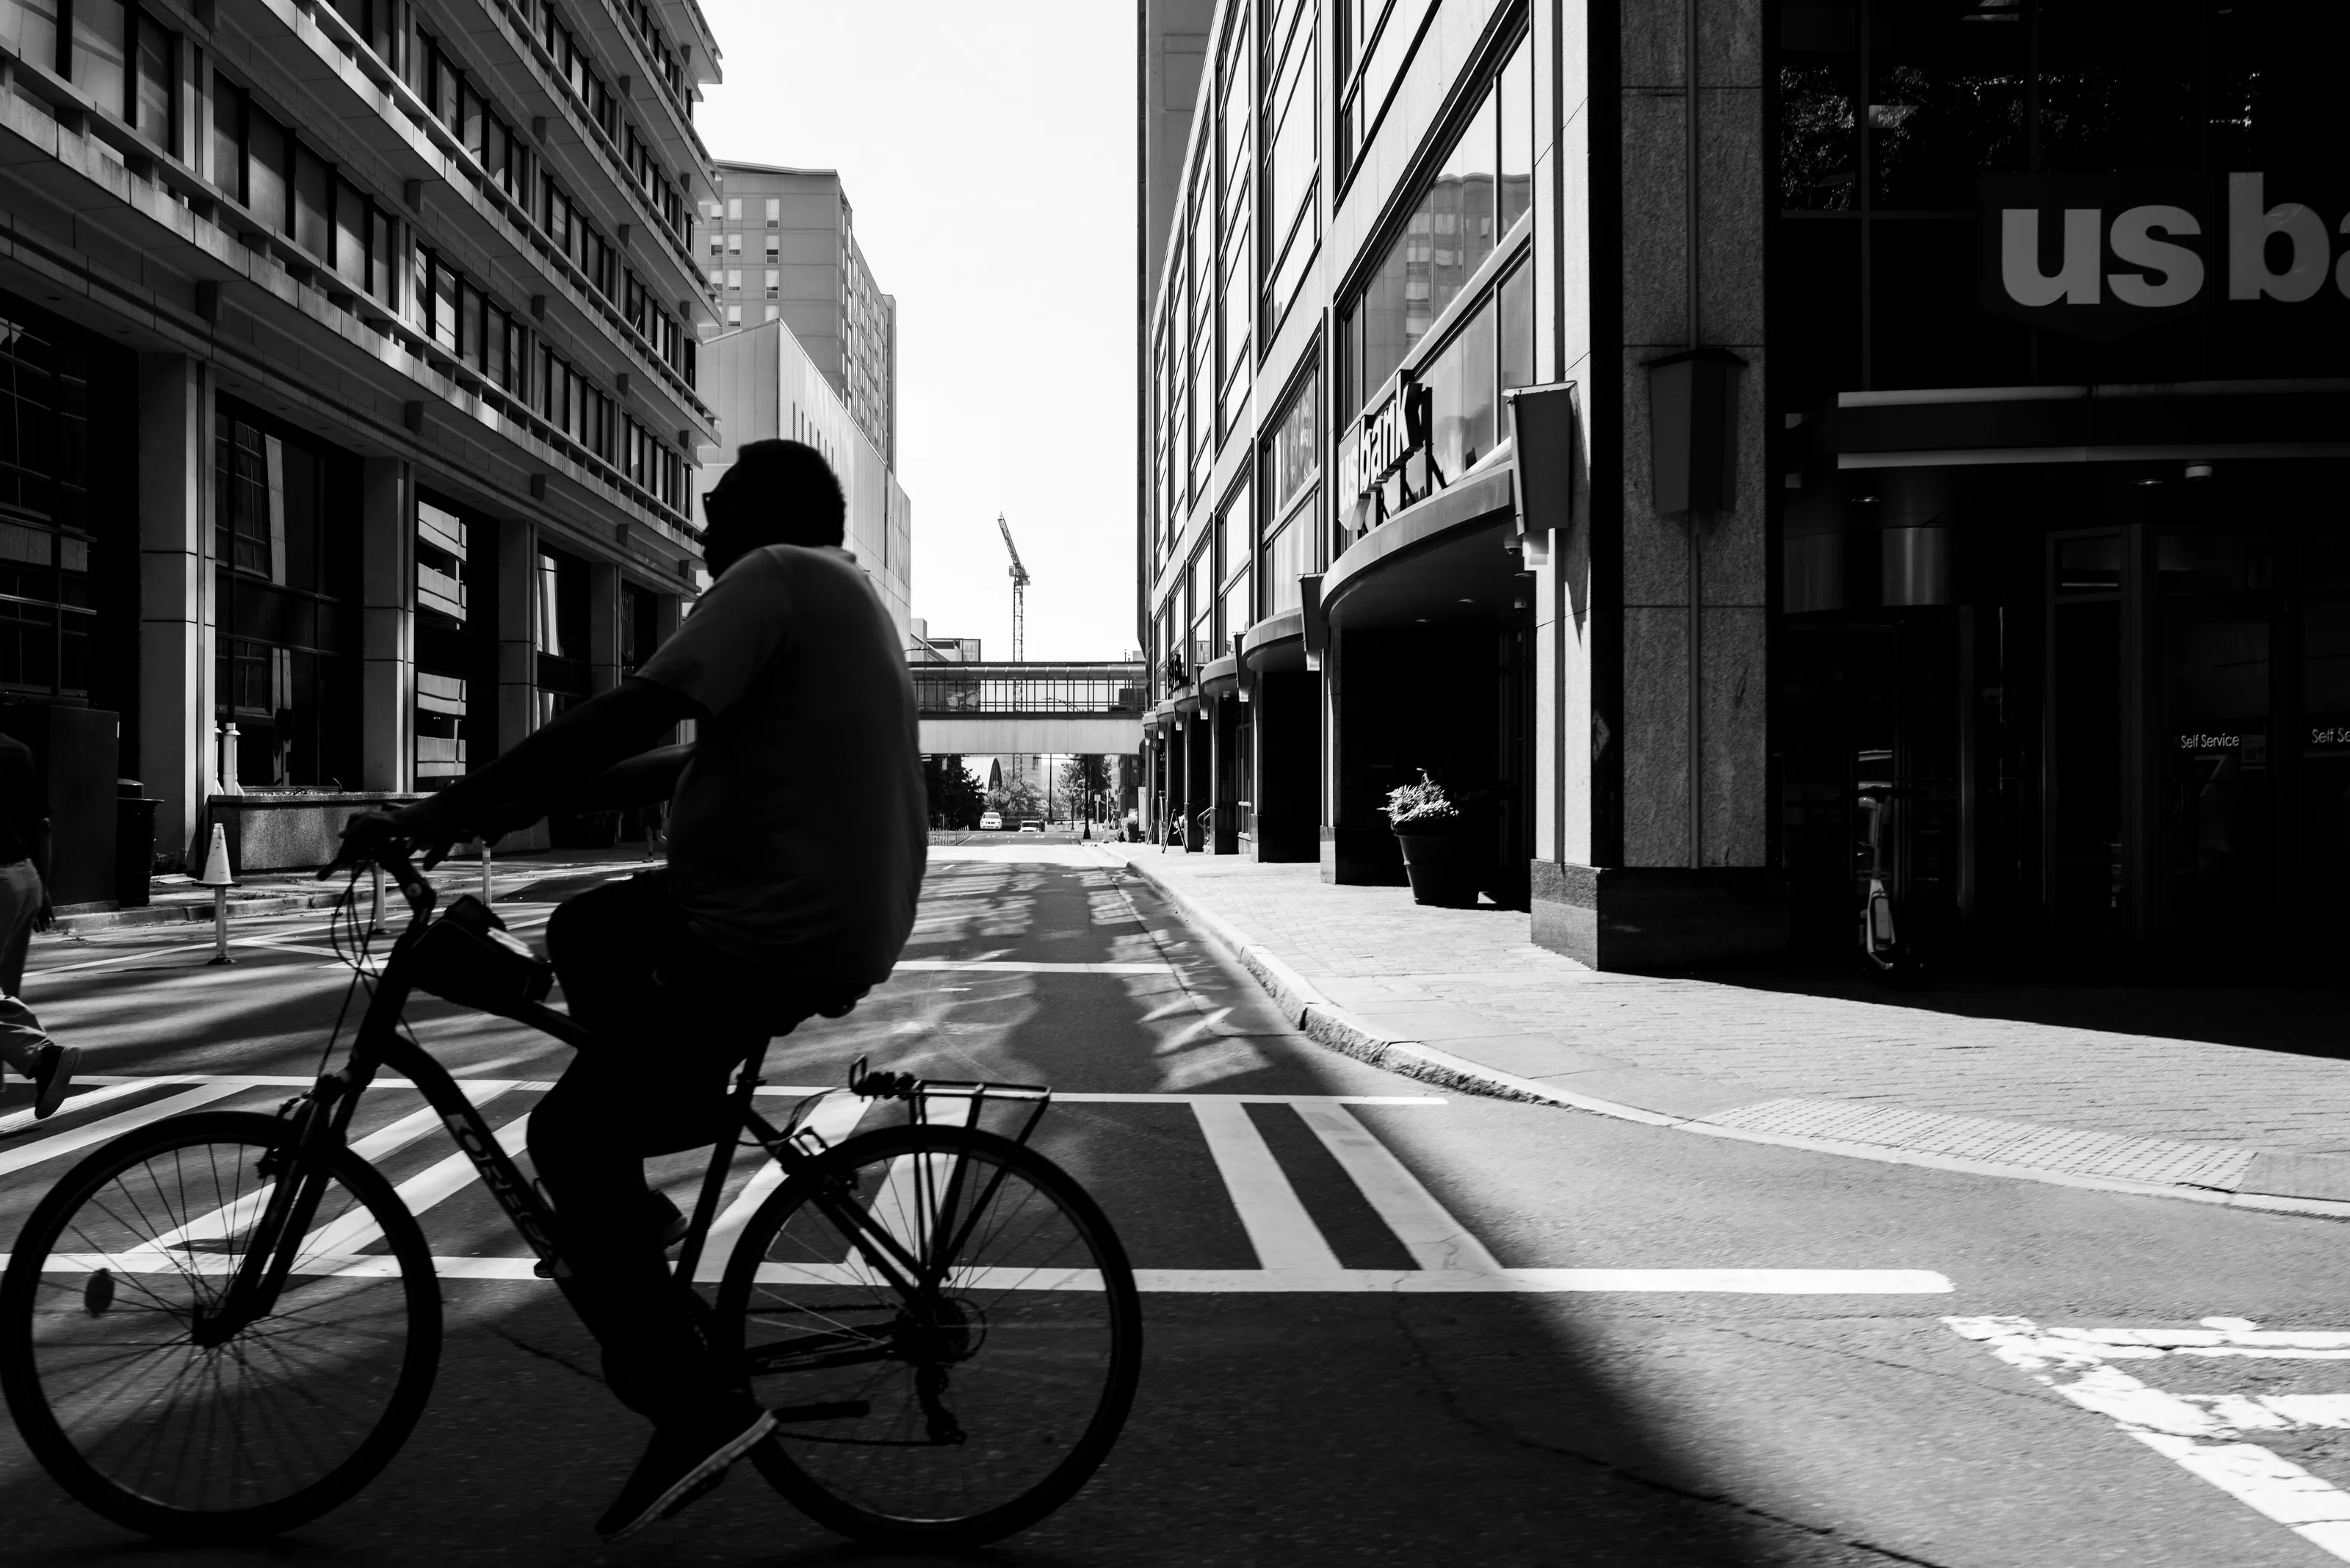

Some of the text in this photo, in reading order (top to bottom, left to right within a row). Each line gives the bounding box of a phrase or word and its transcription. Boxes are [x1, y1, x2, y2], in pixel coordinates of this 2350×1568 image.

[2227, 171, 2350, 303] b
[2181, 733, 2240, 748] Self Service
[2312, 728, 2335, 743] Self
